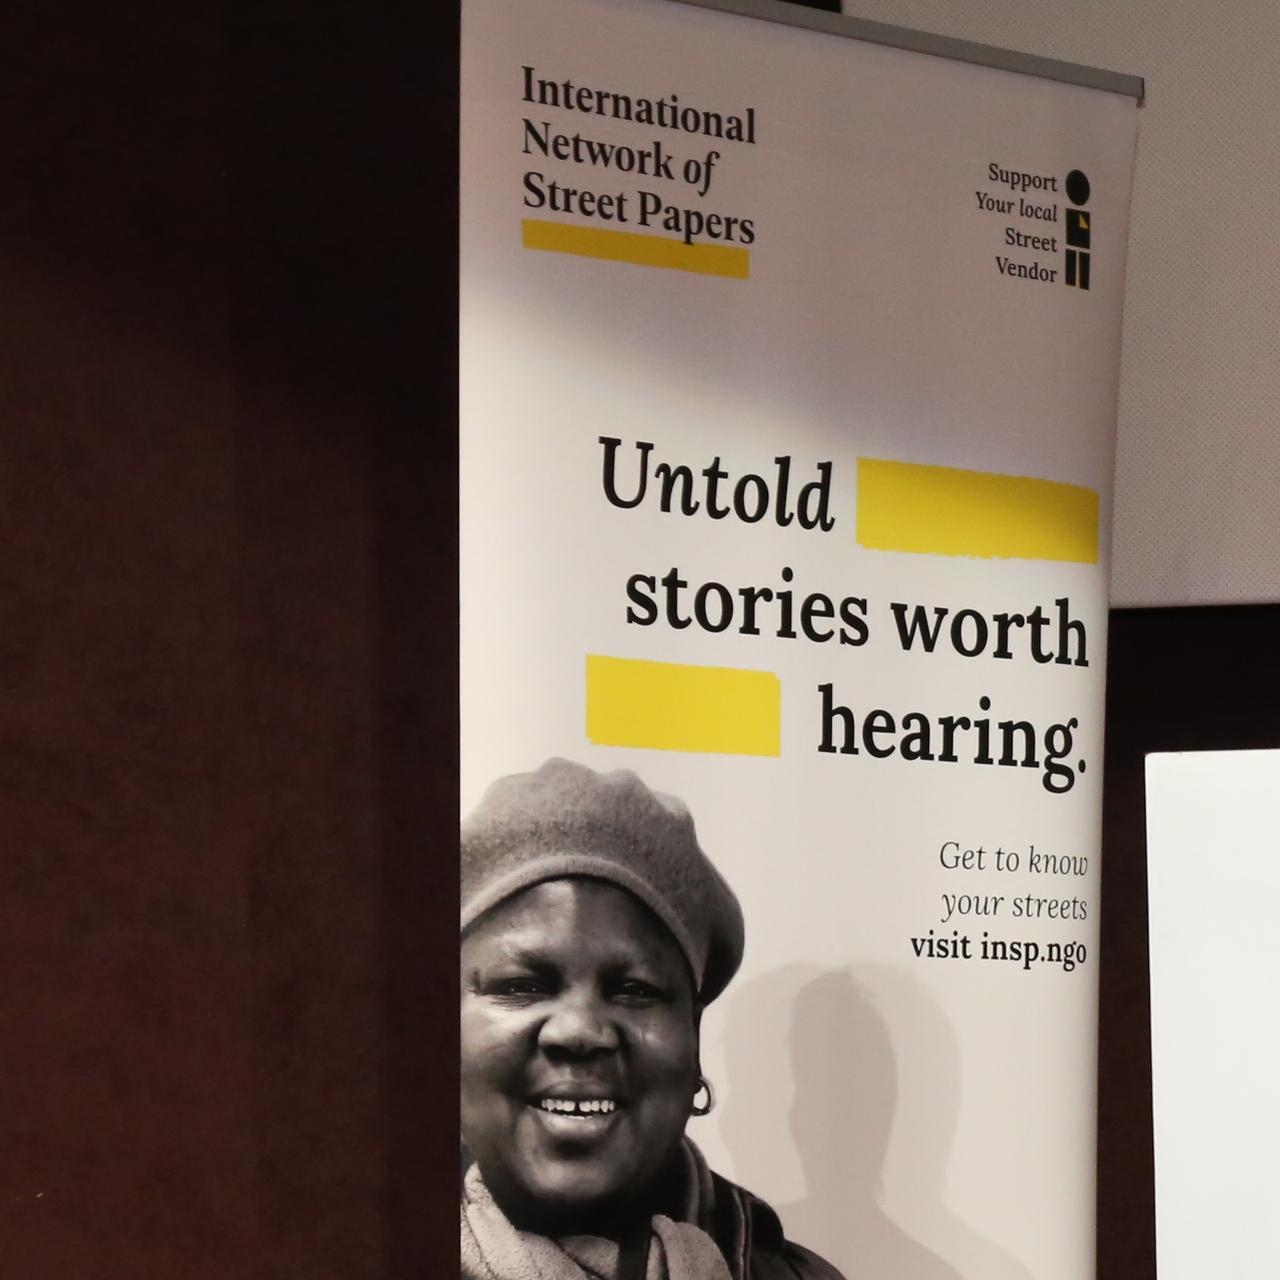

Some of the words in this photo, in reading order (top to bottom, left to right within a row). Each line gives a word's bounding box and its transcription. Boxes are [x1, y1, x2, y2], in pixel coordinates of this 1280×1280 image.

[522, 65, 757, 144] International
[522, 118, 674, 181] Network
[683, 150, 720, 196] of
[988, 162, 1058, 192] Support
[522, 171, 628, 223] Street
[638, 191, 756, 246] Papers
[975, 191, 1015, 215] Your
[1020, 198, 1058, 222] local
[1005, 227, 1058, 253] Street
[995, 256, 1058, 283] Vendor
[598, 436, 836, 532] Untold
[625, 566, 870, 647] stories
[890, 597, 1090, 667] worth
[817, 683, 1087, 794] hearing.
[939, 842, 986, 873] Get
[995, 847, 1020, 873] to
[1028, 844, 1089, 877] know
[941, 891, 1004, 923] your
[1012, 894, 1088, 921] streets
[910, 931, 972, 961] visit
[980, 932, 1088, 972] insp.ngo
